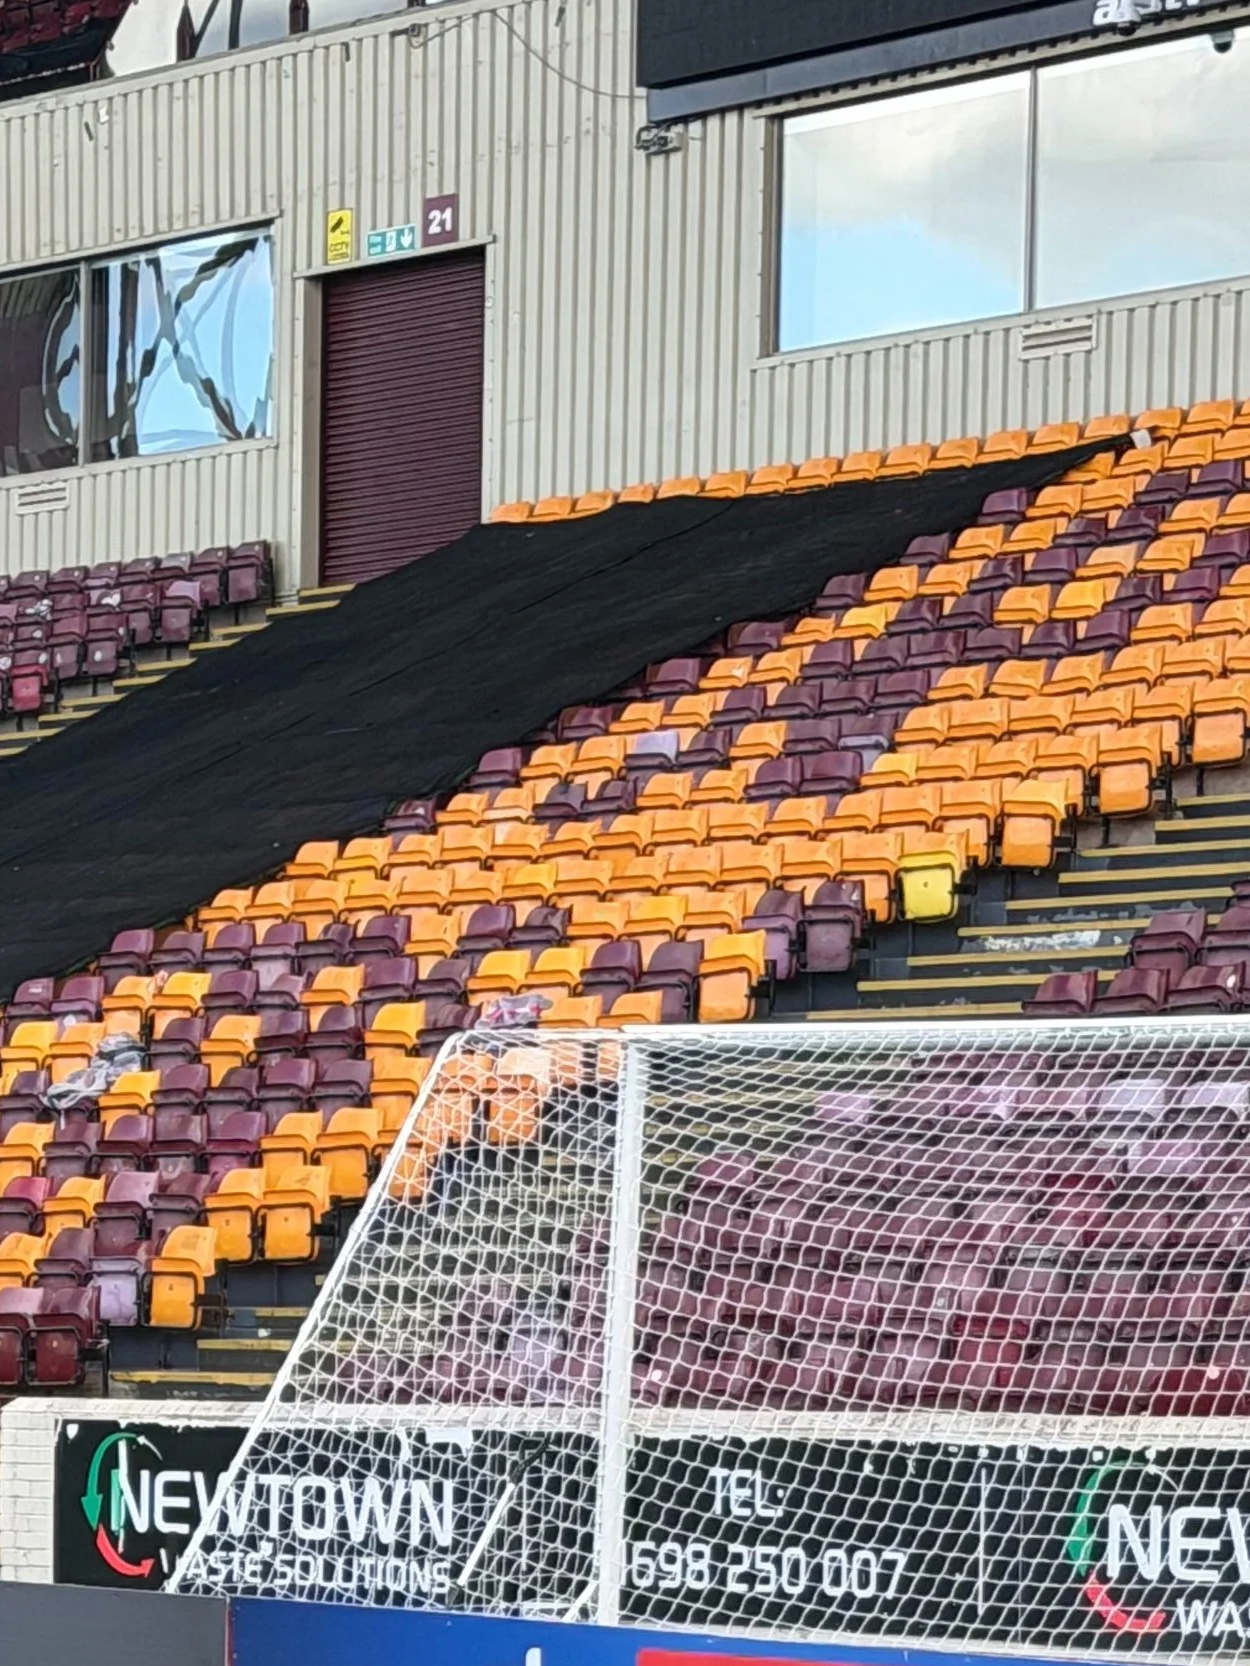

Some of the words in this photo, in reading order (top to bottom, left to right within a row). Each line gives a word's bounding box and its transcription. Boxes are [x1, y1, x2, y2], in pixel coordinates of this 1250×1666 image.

[427, 207, 452, 234] 21
[111, 1470, 452, 1547] NEWTOWN
[710, 1467, 783, 1517] TEL:
[274, 1555, 451, 1594] SOLUTIONS
[726, 1544, 806, 1594] 250
[822, 1549, 906, 1599] 007
[1176, 1599, 1250, 1638] WA
